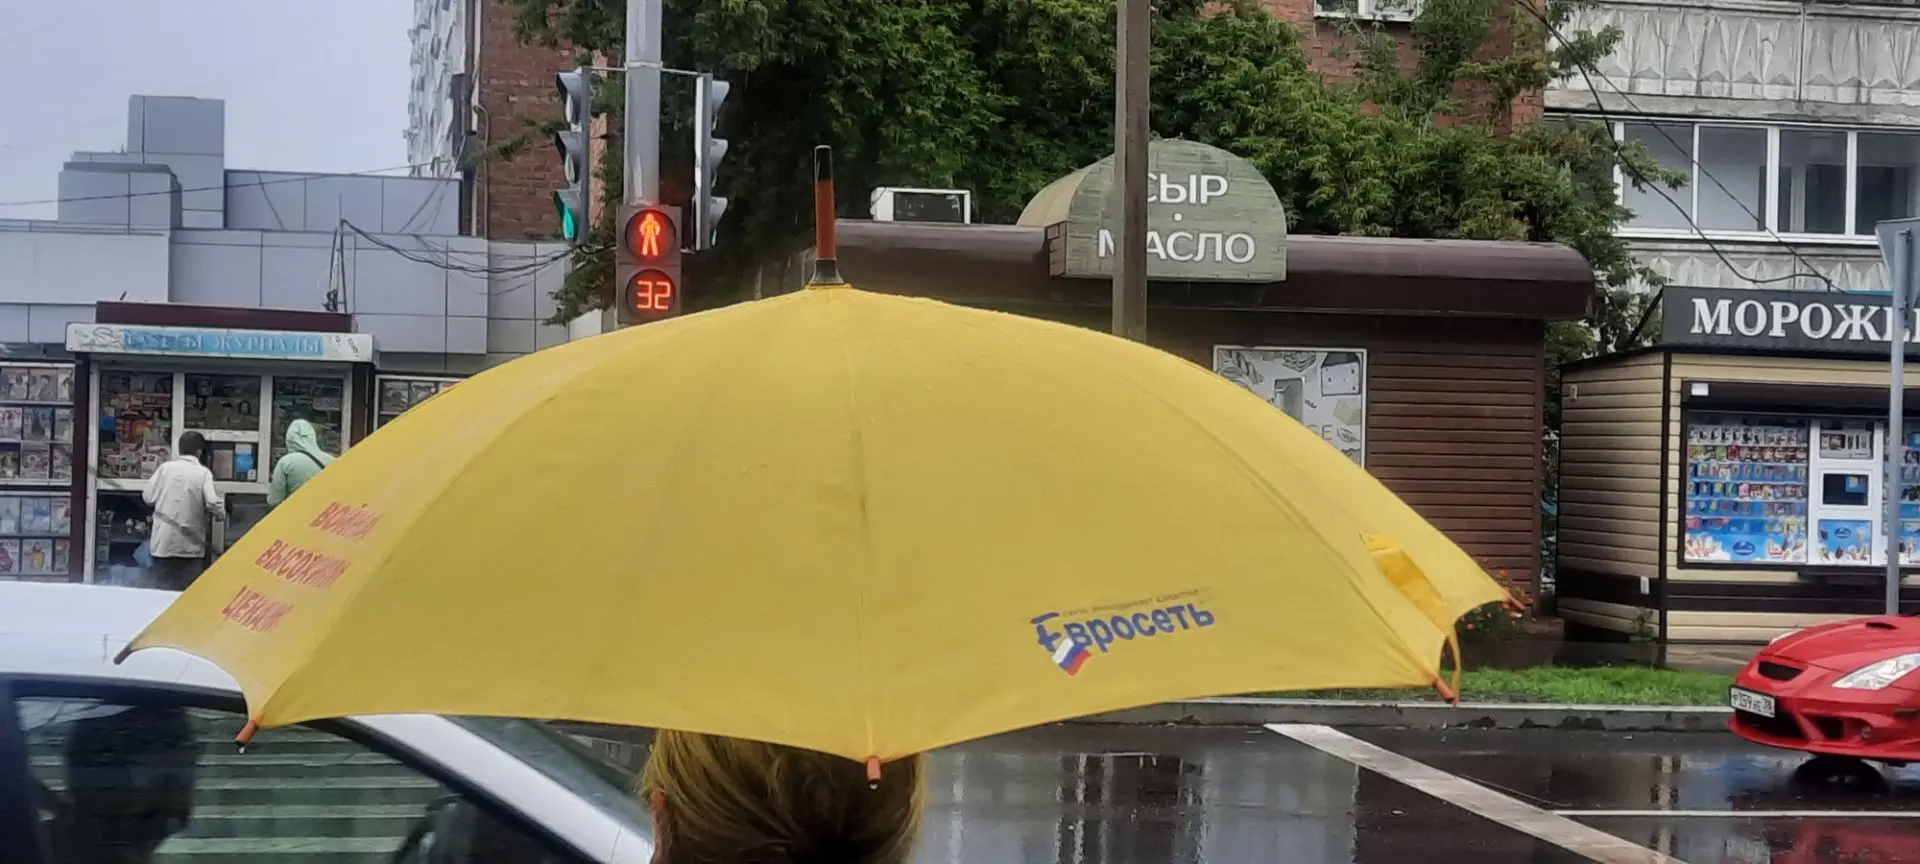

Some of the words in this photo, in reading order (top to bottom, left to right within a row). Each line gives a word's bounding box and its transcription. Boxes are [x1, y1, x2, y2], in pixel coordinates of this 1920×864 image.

[637, 280, 671, 310] 32
[1690, 297, 1920, 343] МОРОЖ
[213, 334, 320, 353] ЖУРНАЛЫ
[1030, 602, 1215, 654] Евросеть
